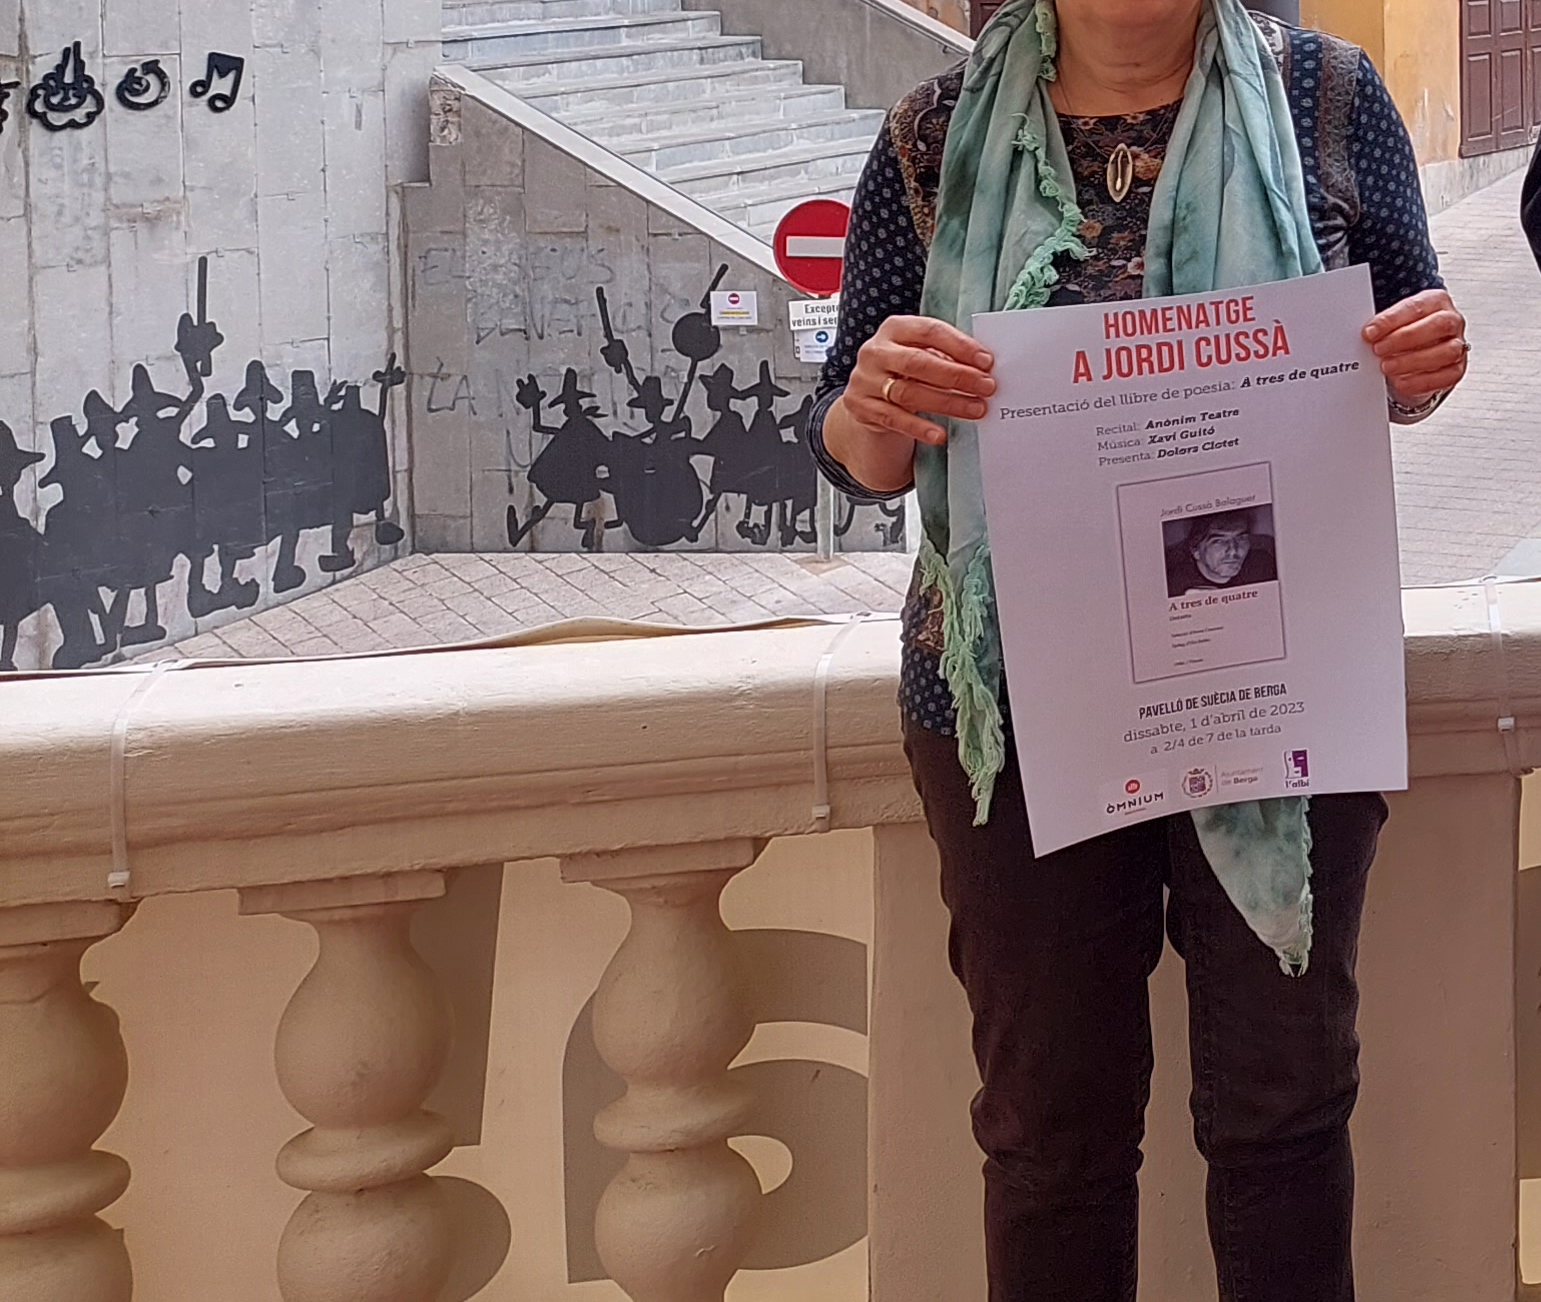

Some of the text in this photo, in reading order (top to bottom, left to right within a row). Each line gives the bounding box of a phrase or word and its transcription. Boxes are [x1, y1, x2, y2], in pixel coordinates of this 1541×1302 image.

[1103, 295, 1256, 340] HOMENATGE
[1073, 319, 1290, 384] A JORDI CUSSÀ
[1000, 361, 1360, 419] Presentació del llibre de poesia: A tres de quatre
[1096, 408, 1240, 437] Recital: Anònim Teatre
[1147, 431, 1177, 445] Xavi
[1180, 426, 1215, 439] Guitó
[1098, 437, 1240, 466] Presenta: Dolors Clotet
[1160, 495, 1257, 517] Jordi Cussà Balaguer
[1168, 589, 1259, 612] A tres de quatre
[1138, 683, 1288, 720] PAVELLÓ DE SUÈCIA DE BERGA
[1123, 701, 1306, 743] dissabte, 1 d'abril de 2023
[1150, 723, 1282, 755] a 2/4 de 7 de la tarda
[1233, 775, 1258, 786] Berga
[1105, 791, 1164, 815] ÒMNIUM
